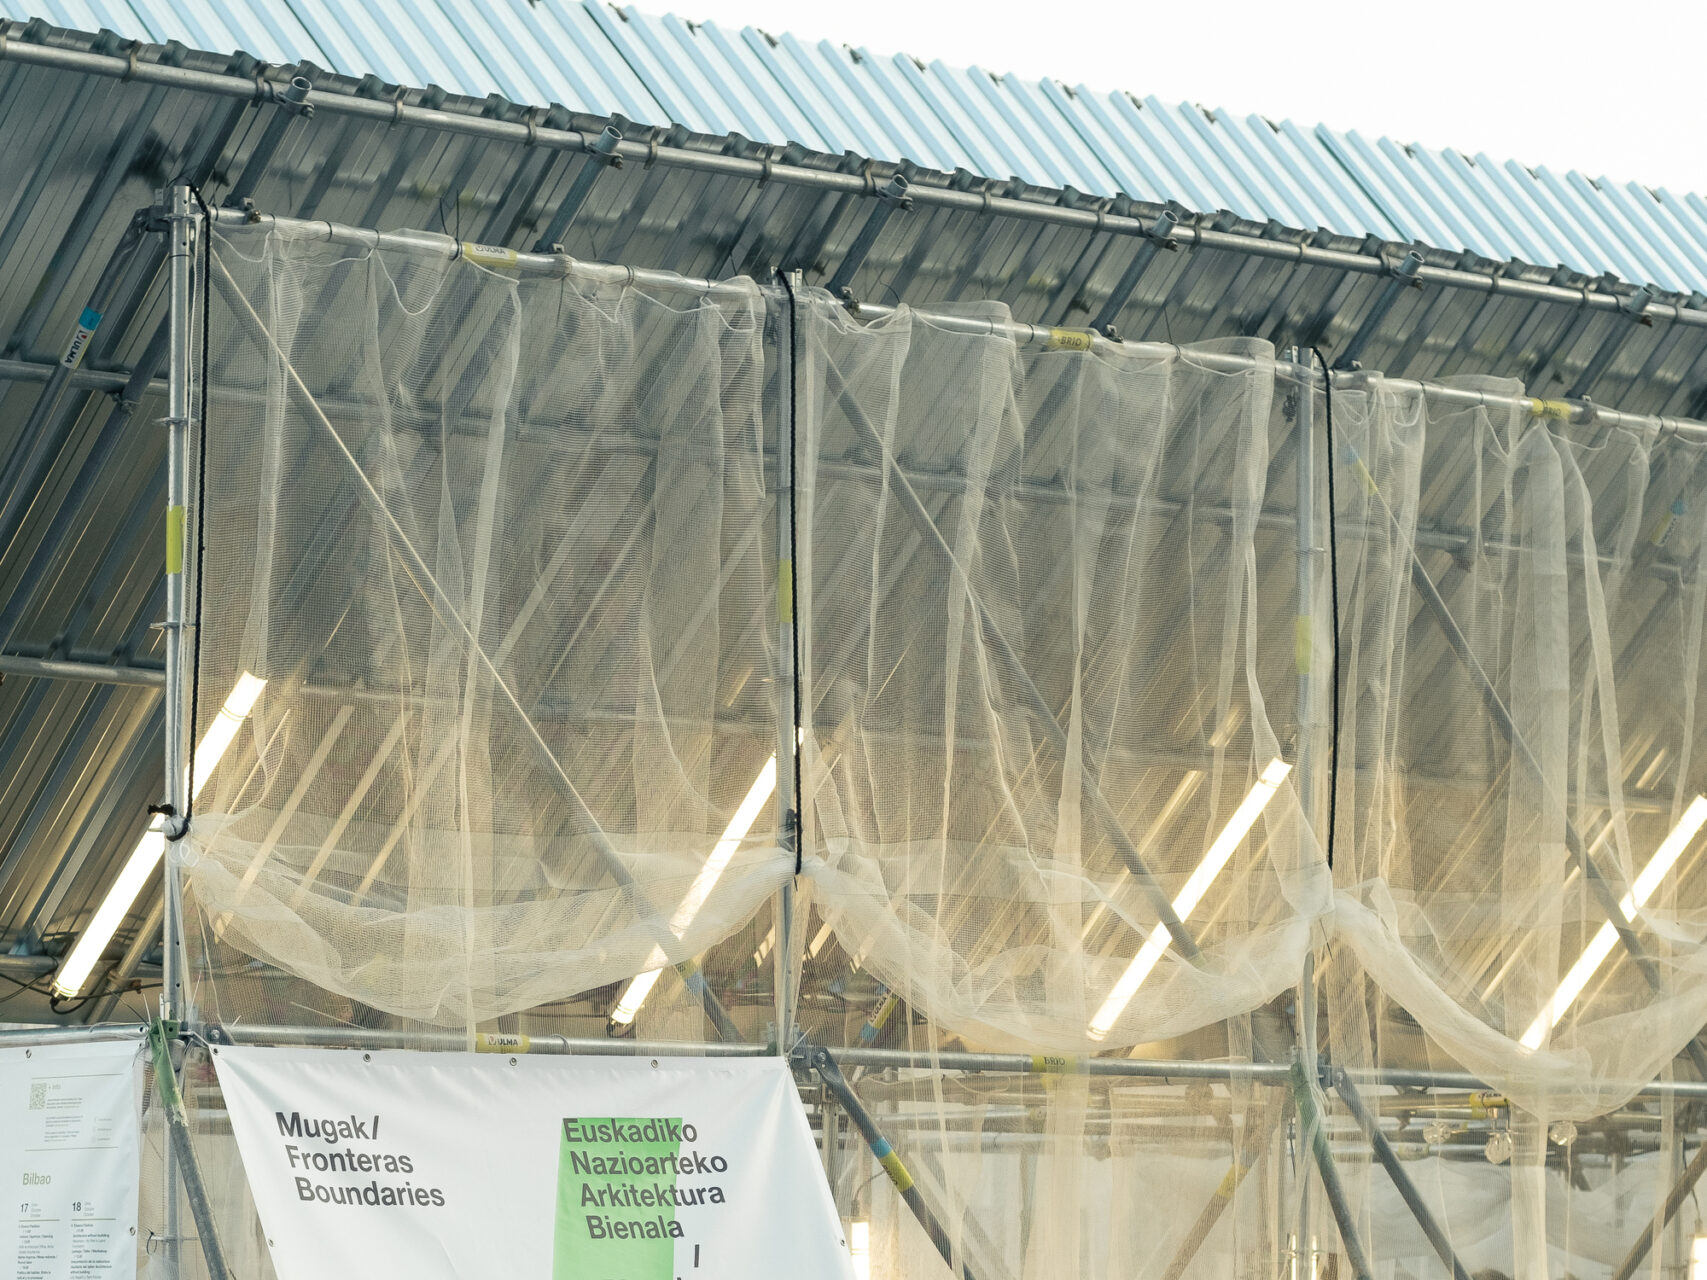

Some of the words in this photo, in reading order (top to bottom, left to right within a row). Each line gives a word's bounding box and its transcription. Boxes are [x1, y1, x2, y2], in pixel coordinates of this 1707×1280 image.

[64, 340, 82, 364] ULMA
[497, 1038, 519, 1046] ULMA
[275, 1111, 380, 1144] Mugak/
[562, 1117, 698, 1143] Euskadiko
[284, 1144, 414, 1174] Fronteras
[570, 1150, 729, 1176] Nazioarteko
[22, 1172, 52, 1186] Bilbao
[294, 1176, 446, 1207] Boundaries
[20, 1203, 29, 1213] 17
[72, 1201, 82, 1212] 18
[580, 1182, 726, 1208] Arkitektura
[585, 1214, 685, 1240] Bienala
